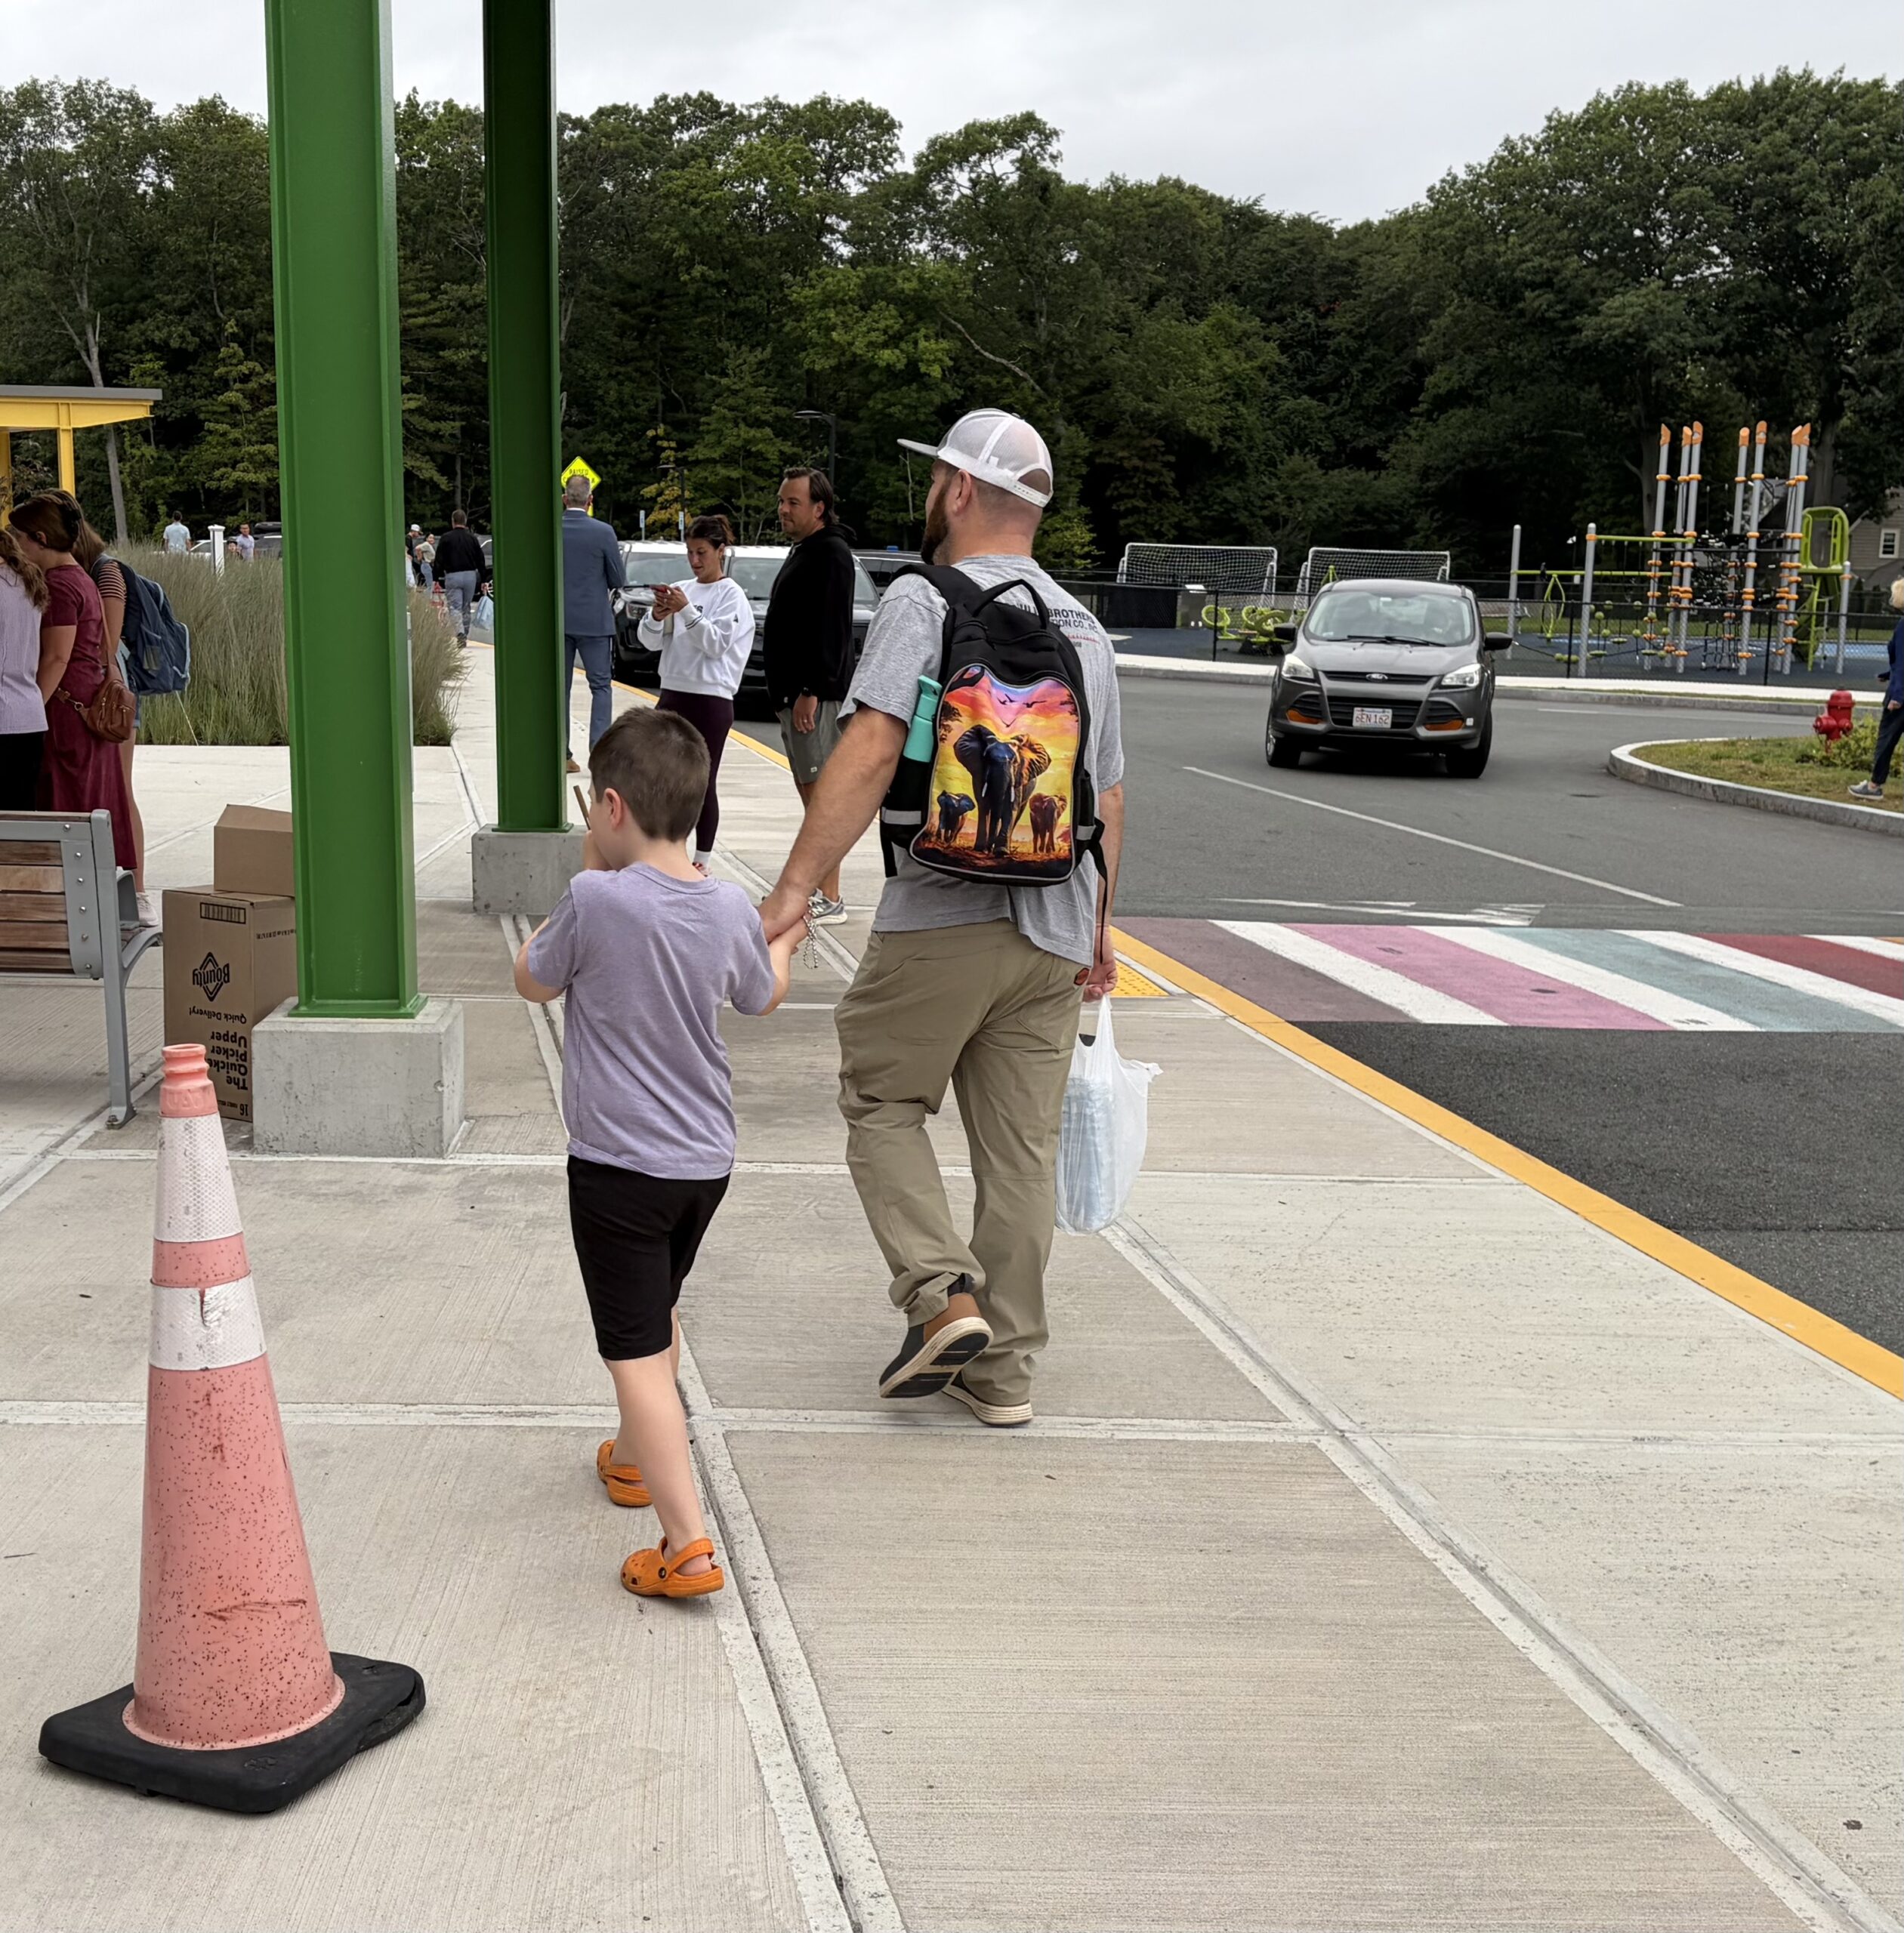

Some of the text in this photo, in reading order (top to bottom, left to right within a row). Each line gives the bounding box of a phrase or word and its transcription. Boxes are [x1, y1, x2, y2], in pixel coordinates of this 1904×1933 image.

[1374, 714, 1390, 725] 162
[192, 963, 230, 987] Bounty
[189, 1006, 247, 1025] Quick Delivery!
[210, 1031, 247, 1048] Upper
[210, 1045, 248, 1062] Picker
[205, 1058, 248, 1076] Quicke
[226, 1076, 248, 1090] The
[239, 1103, 248, 1116] 16
